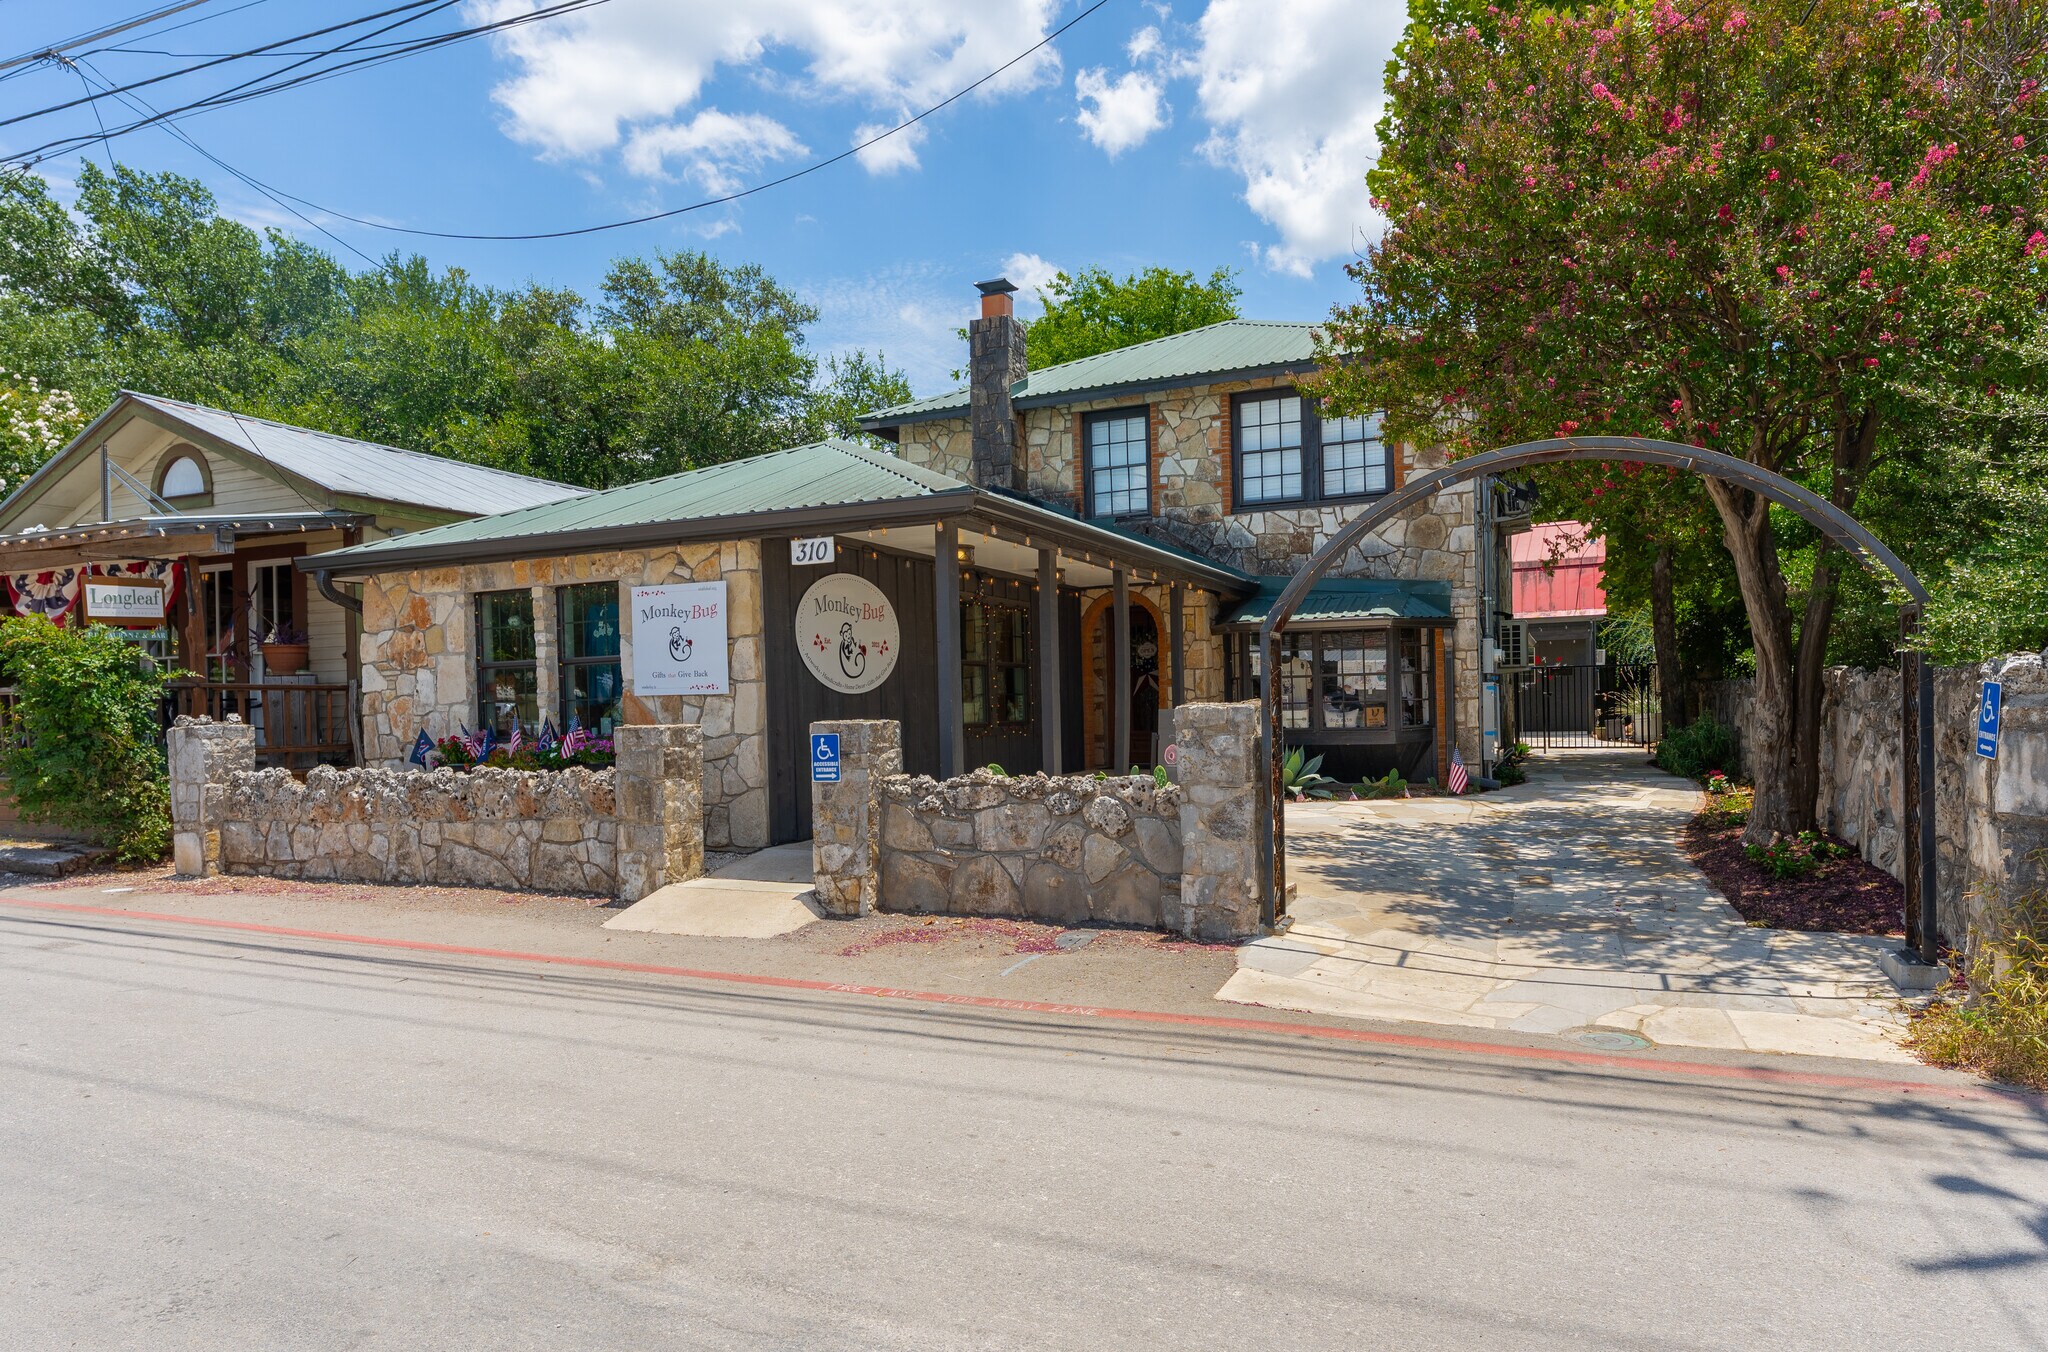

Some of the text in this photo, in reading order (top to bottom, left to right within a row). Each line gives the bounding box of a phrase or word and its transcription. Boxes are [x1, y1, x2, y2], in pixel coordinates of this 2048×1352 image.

[796, 541, 828, 562] 310
[90, 588, 160, 609] Longleaf
[814, 594, 885, 623] MonkeyBug
[641, 603, 718, 624] MonkeyBug
[694, 670, 708, 678] Back
